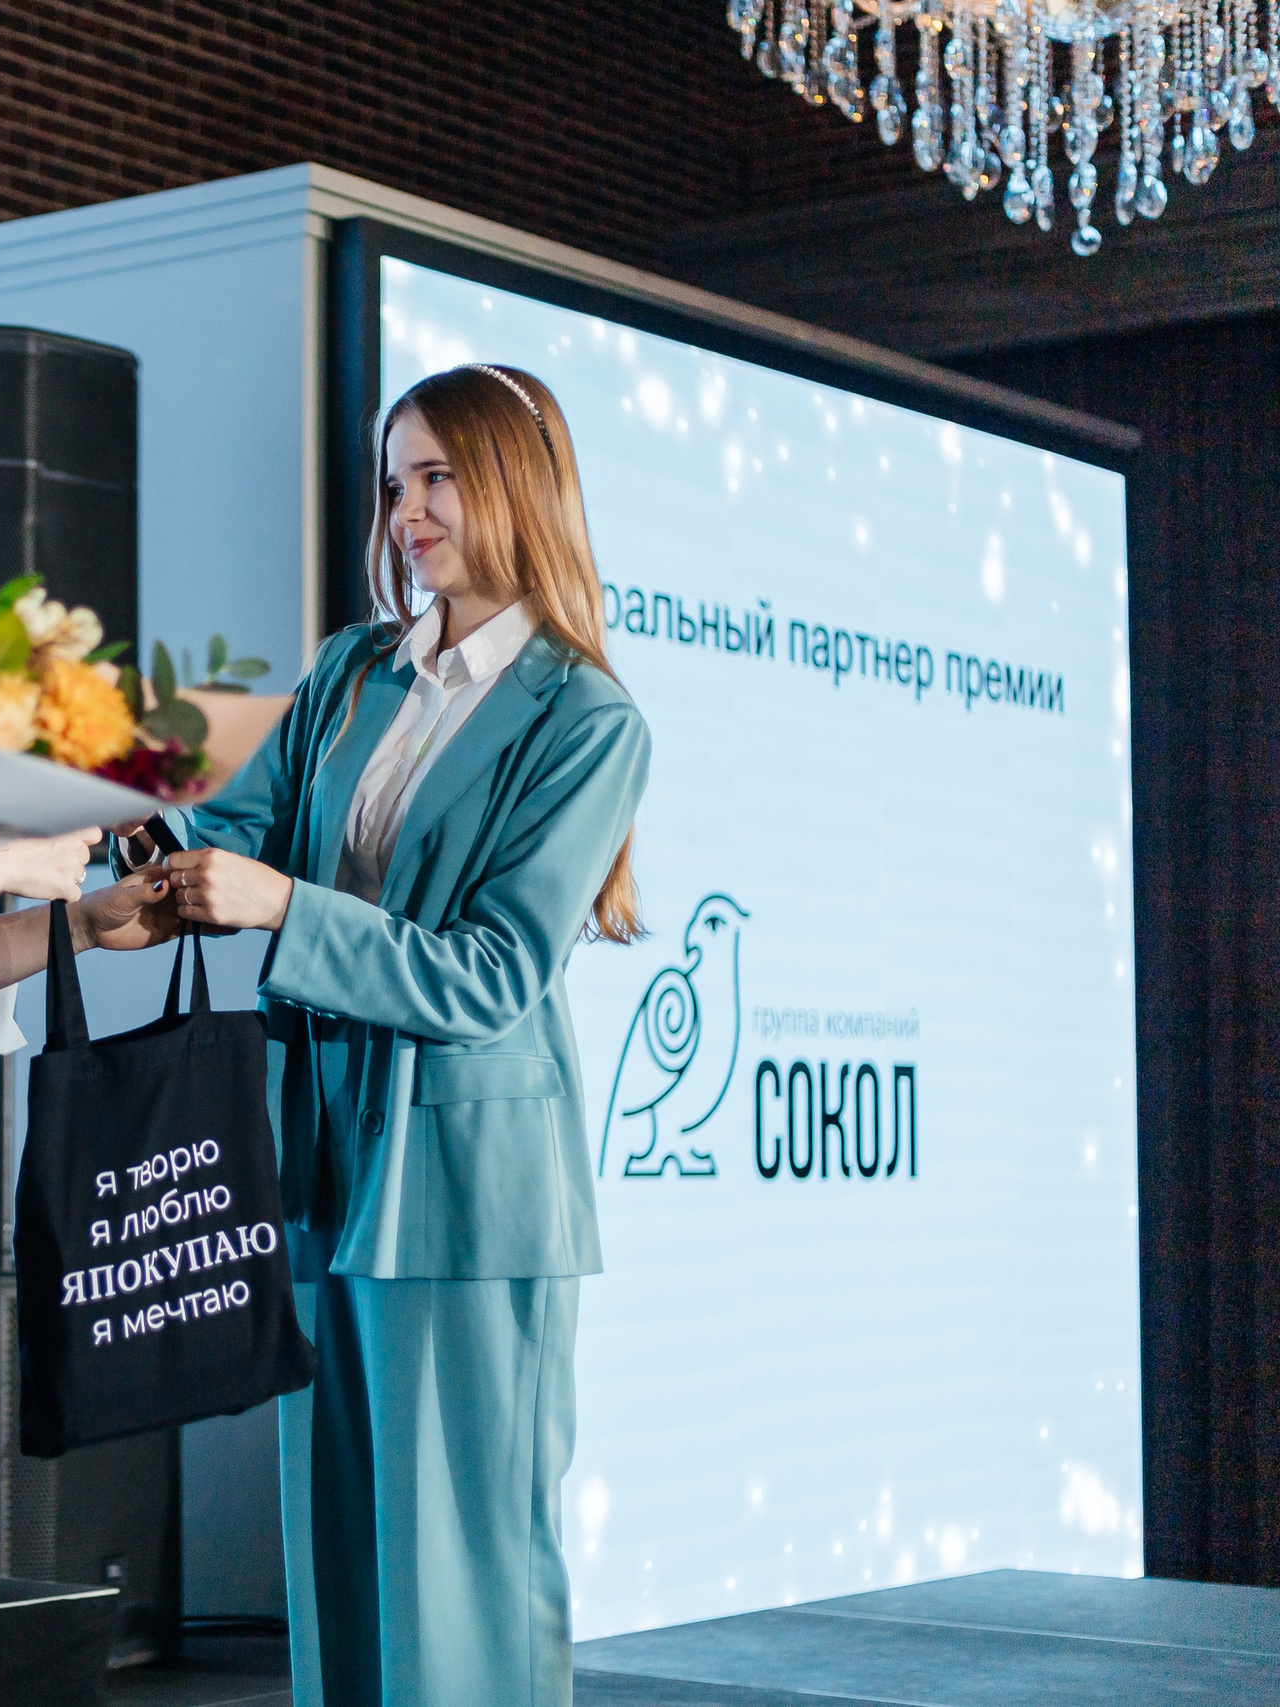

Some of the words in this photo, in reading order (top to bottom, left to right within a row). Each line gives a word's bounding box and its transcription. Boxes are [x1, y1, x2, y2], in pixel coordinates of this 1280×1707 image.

[788, 615, 934, 704] партнер
[945, 648, 1065, 715] премии
[752, 1005, 821, 1042] группа
[825, 1005, 920, 1041] компаний
[126, 1138, 220, 1190] творю
[120, 1184, 231, 1242] люблю
[60, 1221, 278, 1306] ЯПОКУПАЮ
[122, 1279, 250, 1339] мечтаю
